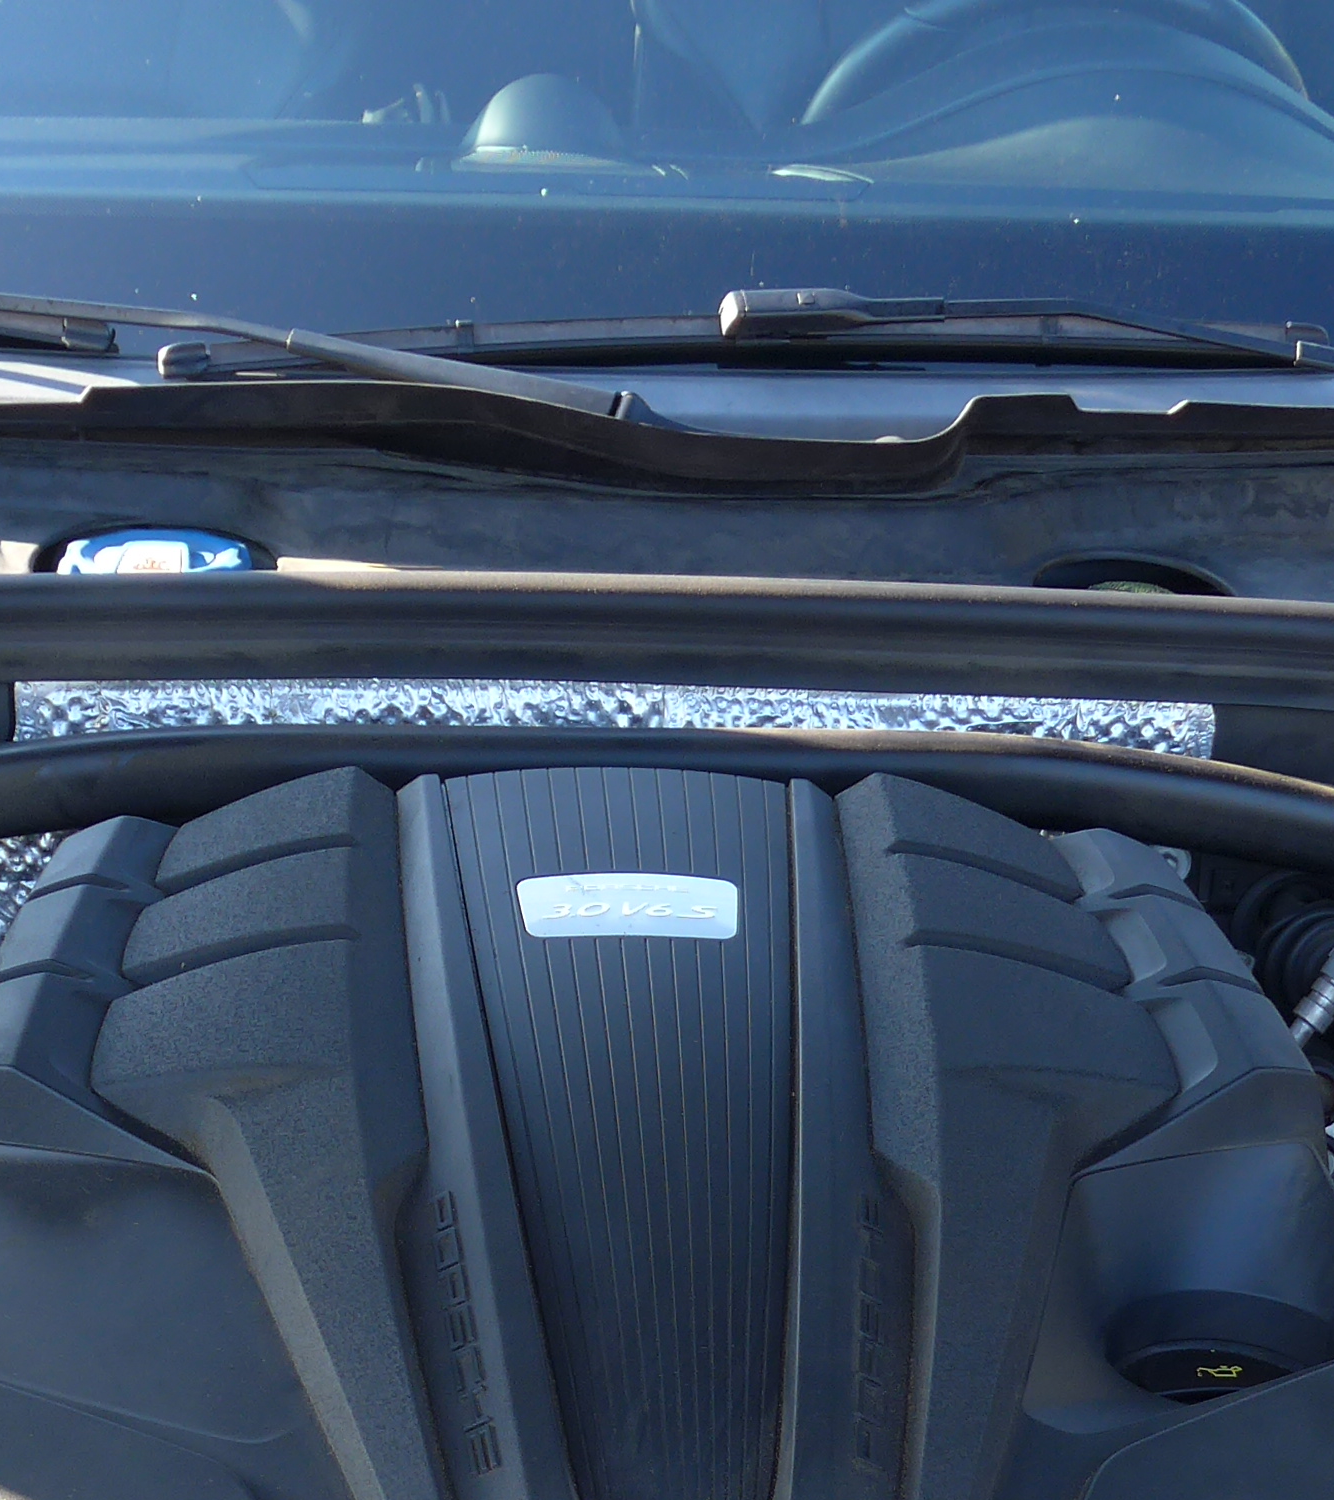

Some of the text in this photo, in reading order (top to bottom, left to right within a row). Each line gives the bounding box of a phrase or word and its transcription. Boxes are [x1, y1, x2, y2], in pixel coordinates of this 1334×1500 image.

[542, 902, 718, 919] 3.0 V6 S
[434, 1190, 503, 1478] PORSCHE
